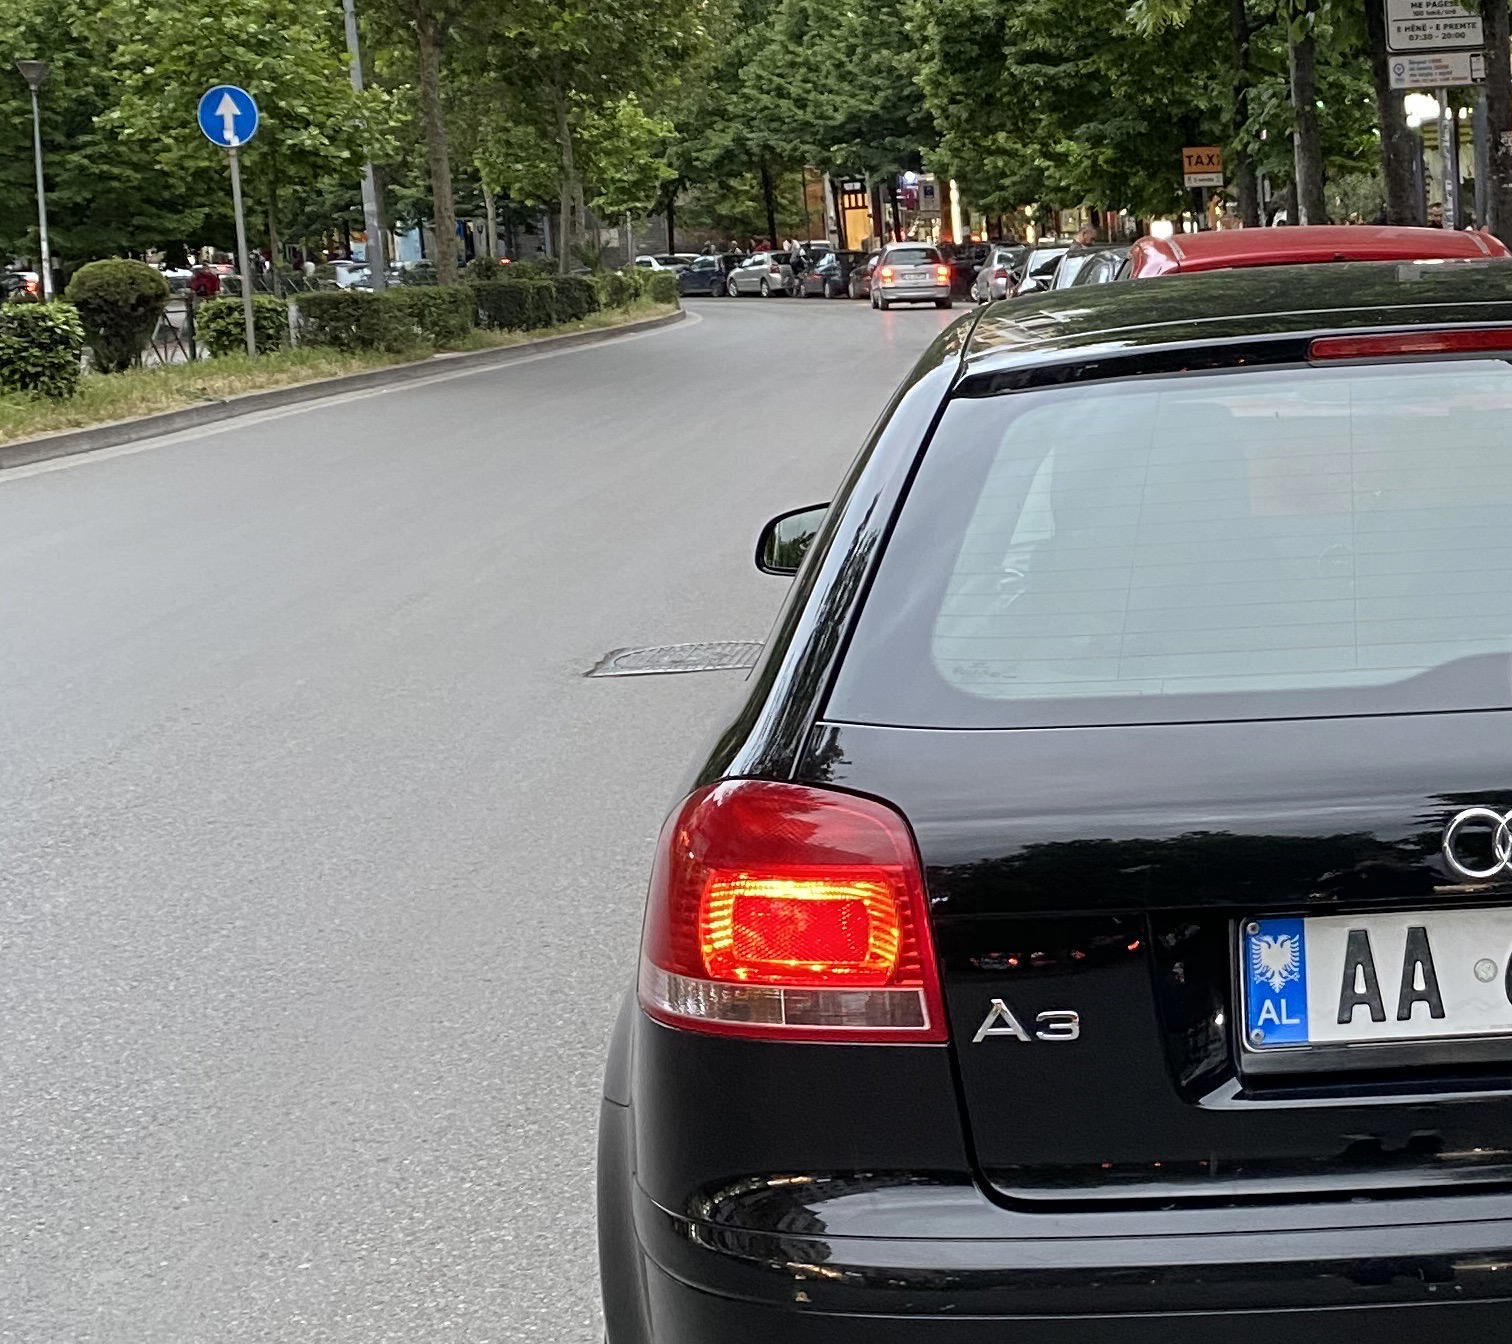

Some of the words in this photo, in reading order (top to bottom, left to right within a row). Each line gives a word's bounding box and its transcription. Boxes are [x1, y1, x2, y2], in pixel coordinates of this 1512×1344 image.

[1410, 1, 1423, 9] ME
[1443, 22, 1477, 31] PREMTE
[1336, 926, 1446, 1025] AA
[971, 997, 1081, 1044] A3
[1257, 999, 1300, 1027] AL
